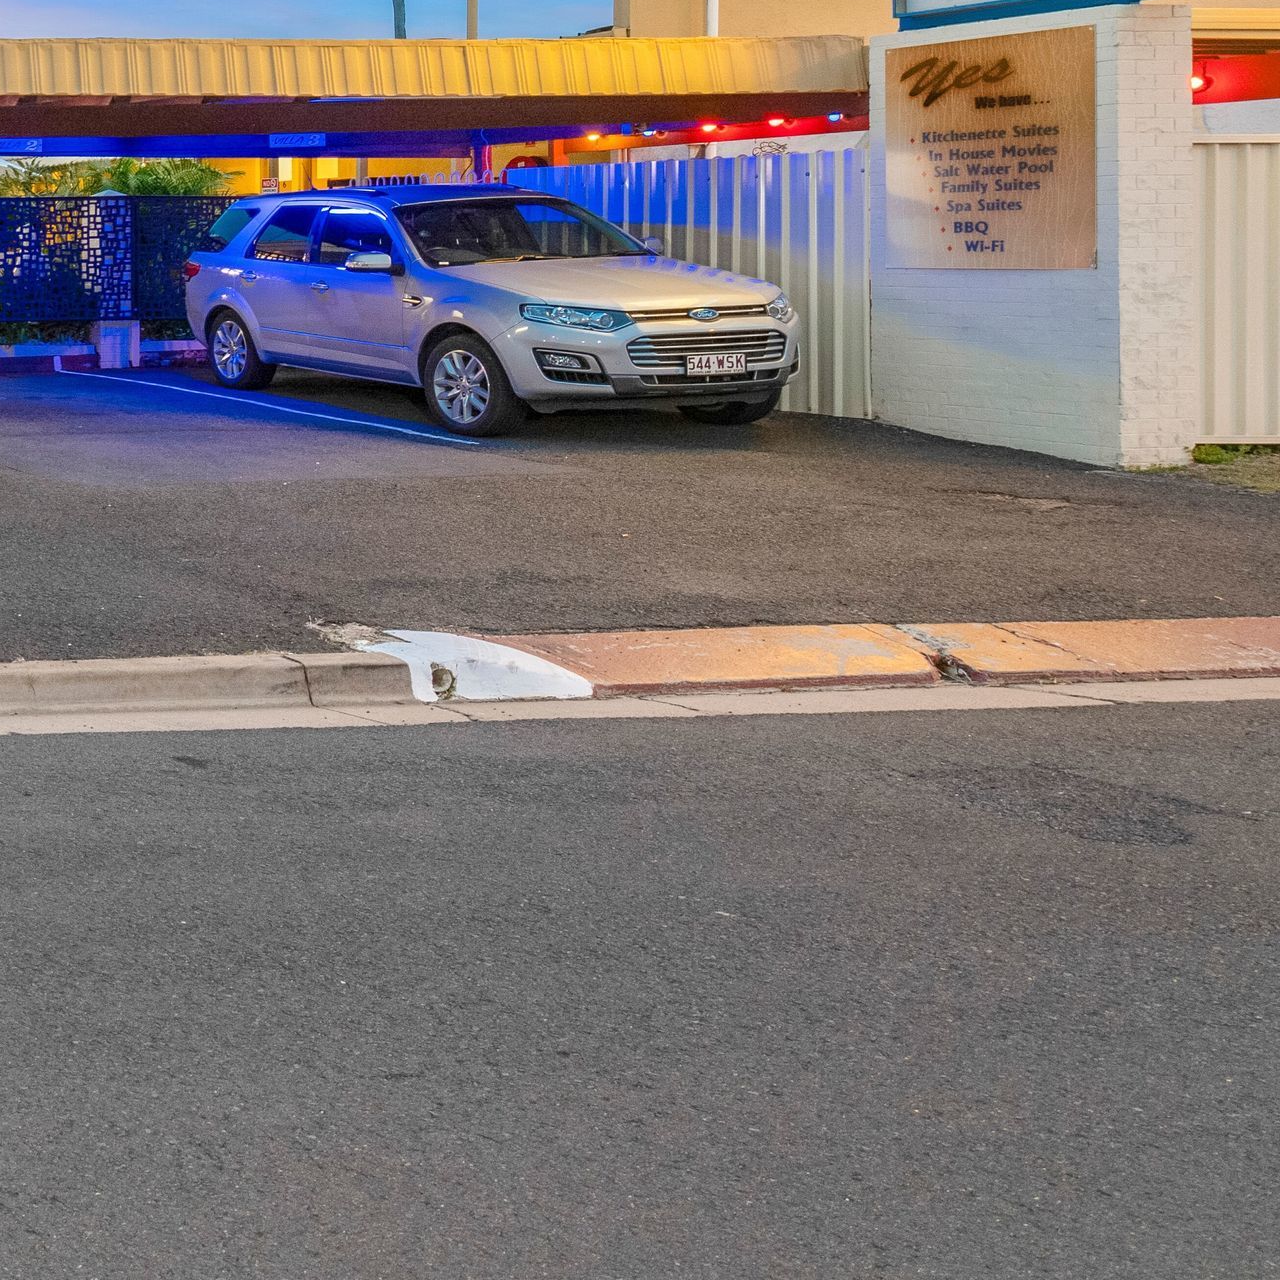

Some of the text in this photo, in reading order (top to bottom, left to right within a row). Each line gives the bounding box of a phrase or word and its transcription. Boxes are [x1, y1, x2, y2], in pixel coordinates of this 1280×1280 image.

[900, 56, 1015, 108] Yes
[975, 96, 997, 109] We
[308, 134, 321, 145] 3
[922, 124, 1060, 144] Kitchenette Suites
[24, 140, 38, 151] 2
[928, 143, 1058, 162] In House Movies
[934, 159, 1054, 178] Salt Water Pool
[941, 179, 1040, 195] Family Suites
[947, 199, 1023, 214] Spa Suites
[953, 221, 988, 235] BBQ
[965, 240, 1005, 252] Wi-Fi
